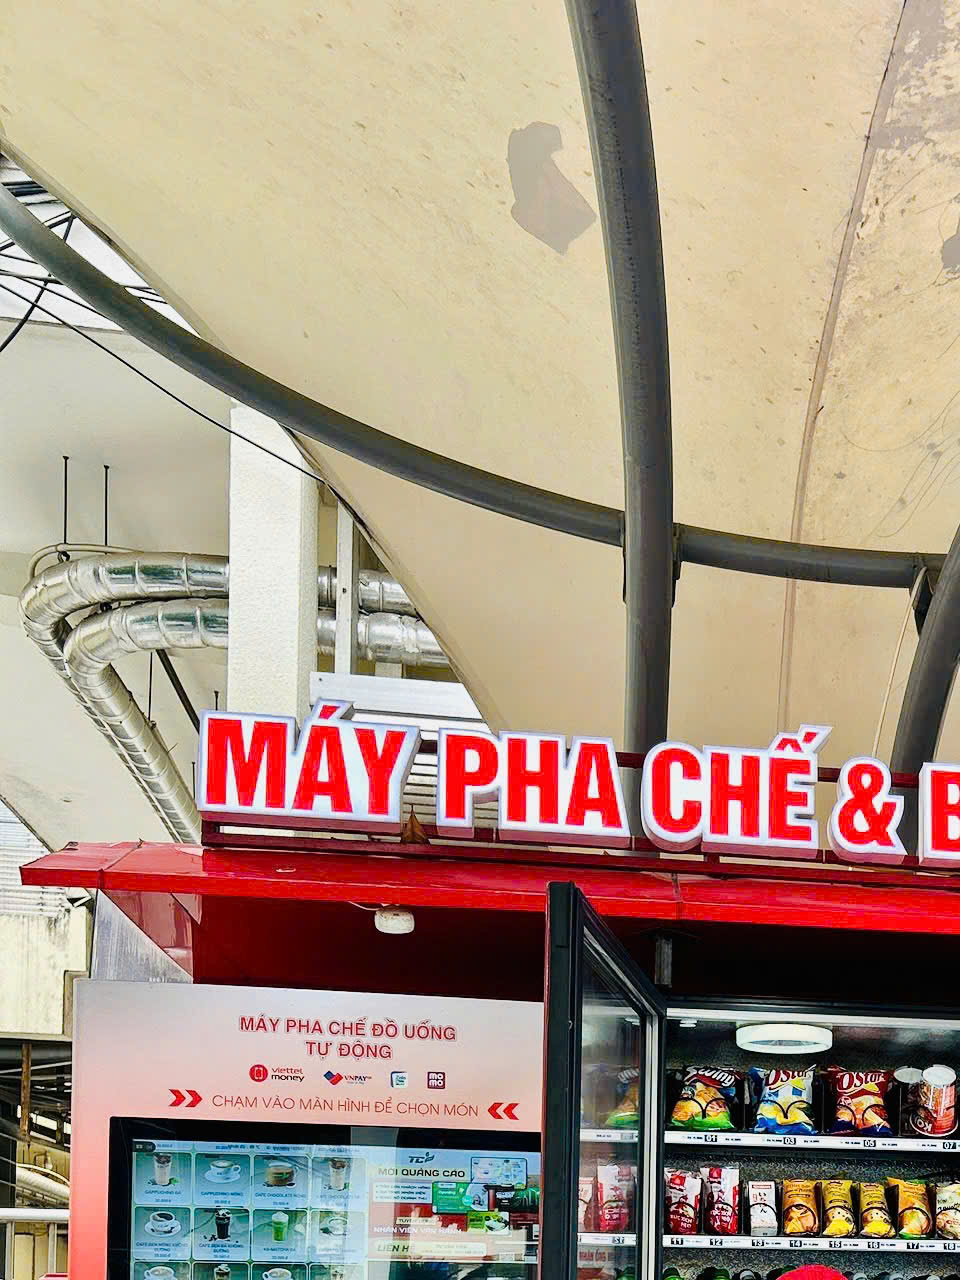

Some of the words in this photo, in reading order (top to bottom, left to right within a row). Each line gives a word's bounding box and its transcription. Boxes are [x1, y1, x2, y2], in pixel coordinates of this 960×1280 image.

[205, 702, 410, 814] MÁY
[444, 733, 623, 830] PHA
[648, 730, 824, 842] CHẾ
[837, 764, 899, 846] &
[240, 1014, 280, 1032] MÁY
[286, 1019, 323, 1034] PHA
[328, 1017, 367, 1036] CHẾ
[372, 1018, 398, 1038] ĐỒ
[404, 1019, 456, 1041] UỐNG
[306, 1041, 332, 1060] TỰ
[339, 1041, 392, 1060] ĐỘNG
[271, 1074, 305, 1083] money
[212, 1094, 258, 1111] CHẠM
[263, 1095, 295, 1109] VÀO
[300, 1096, 333, 1111] MÀN
[338, 1097, 370, 1112] HÌNH
[374, 1097, 392, 1114] ĐỂ
[397, 1101, 440, 1117] CHỌN
[444, 1101, 479, 1117] MÓN
[704, 1135, 718, 1143] 01
[783, 1137, 797, 1145] 03
[942, 1142, 957, 1150] 07
[752, 1239, 765, 1247] 13
[907, 1242, 919, 1250] 17
